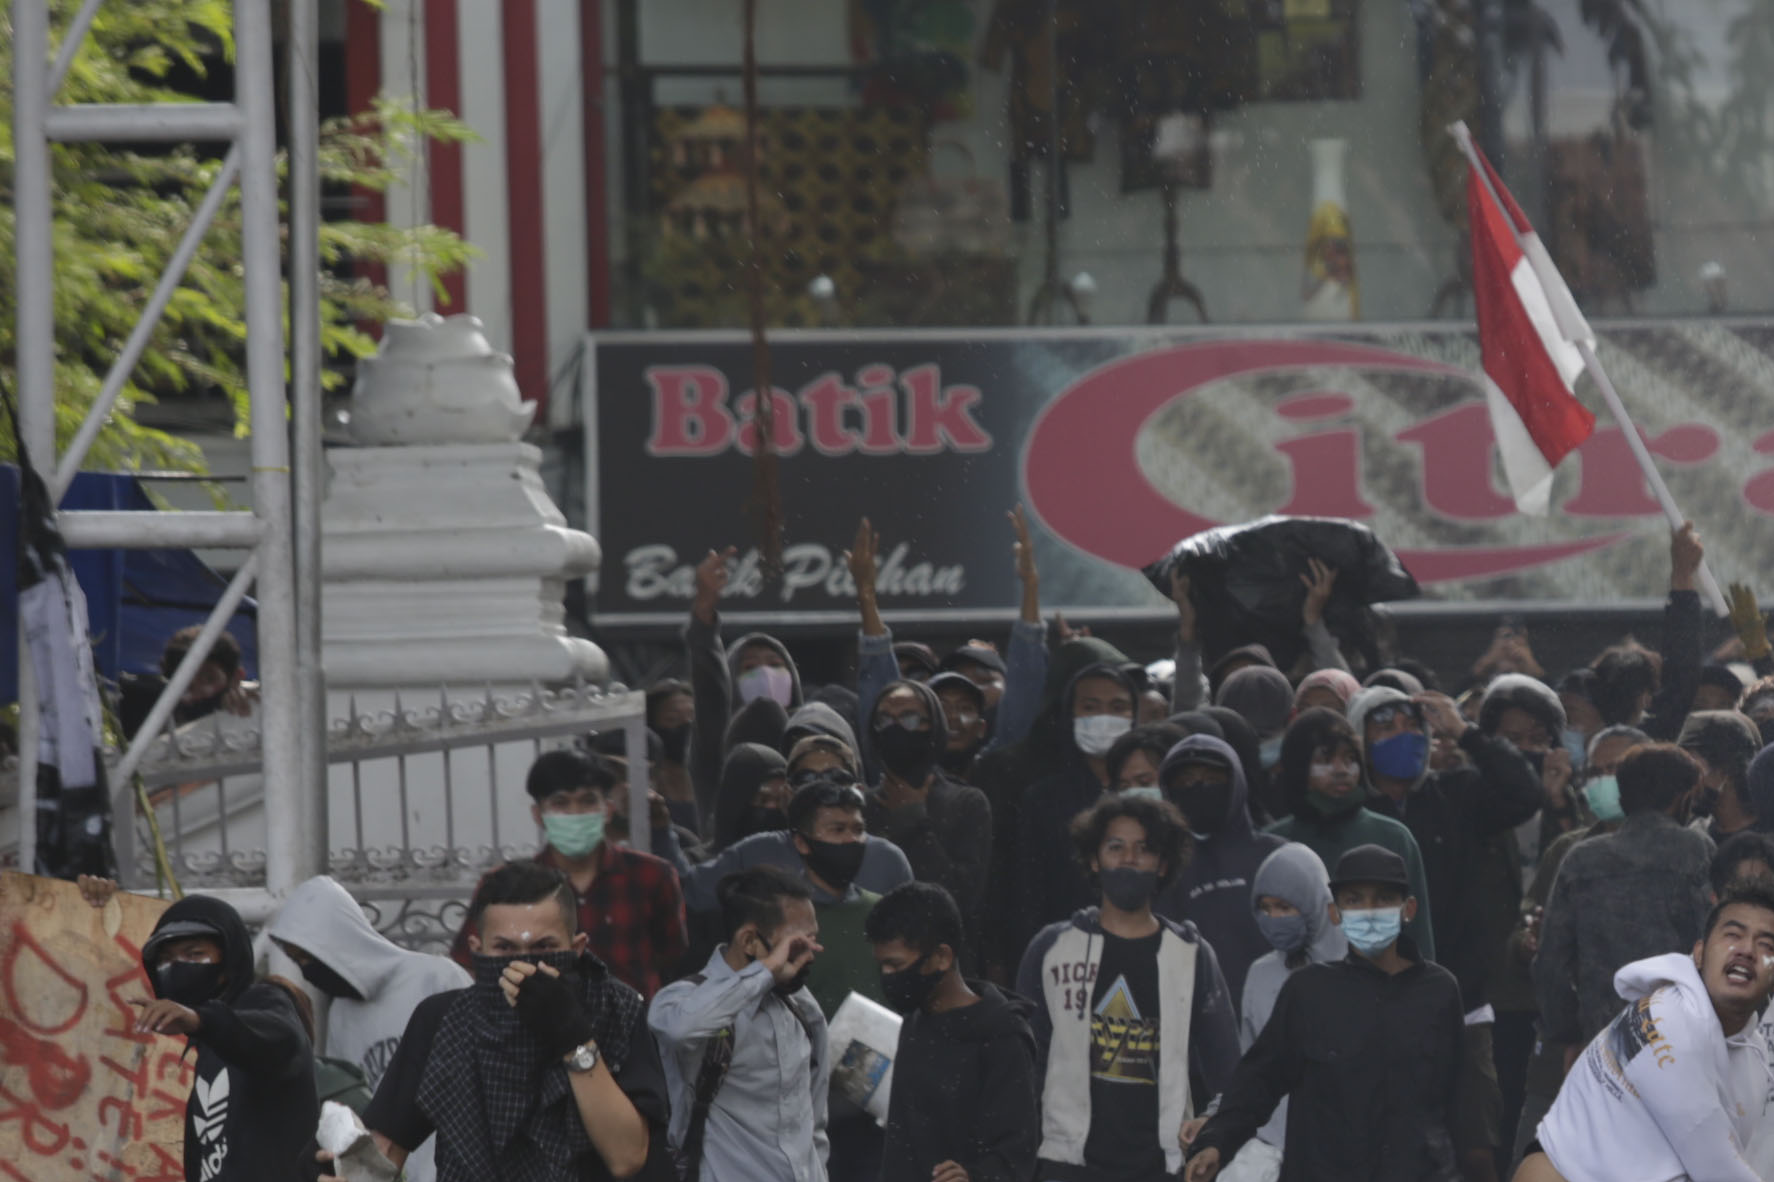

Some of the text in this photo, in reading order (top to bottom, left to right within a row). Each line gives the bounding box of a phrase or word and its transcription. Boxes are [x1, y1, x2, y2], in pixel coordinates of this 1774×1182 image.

[644, 362, 993, 457] Batik
[623, 541, 966, 602] Baik Pihan
